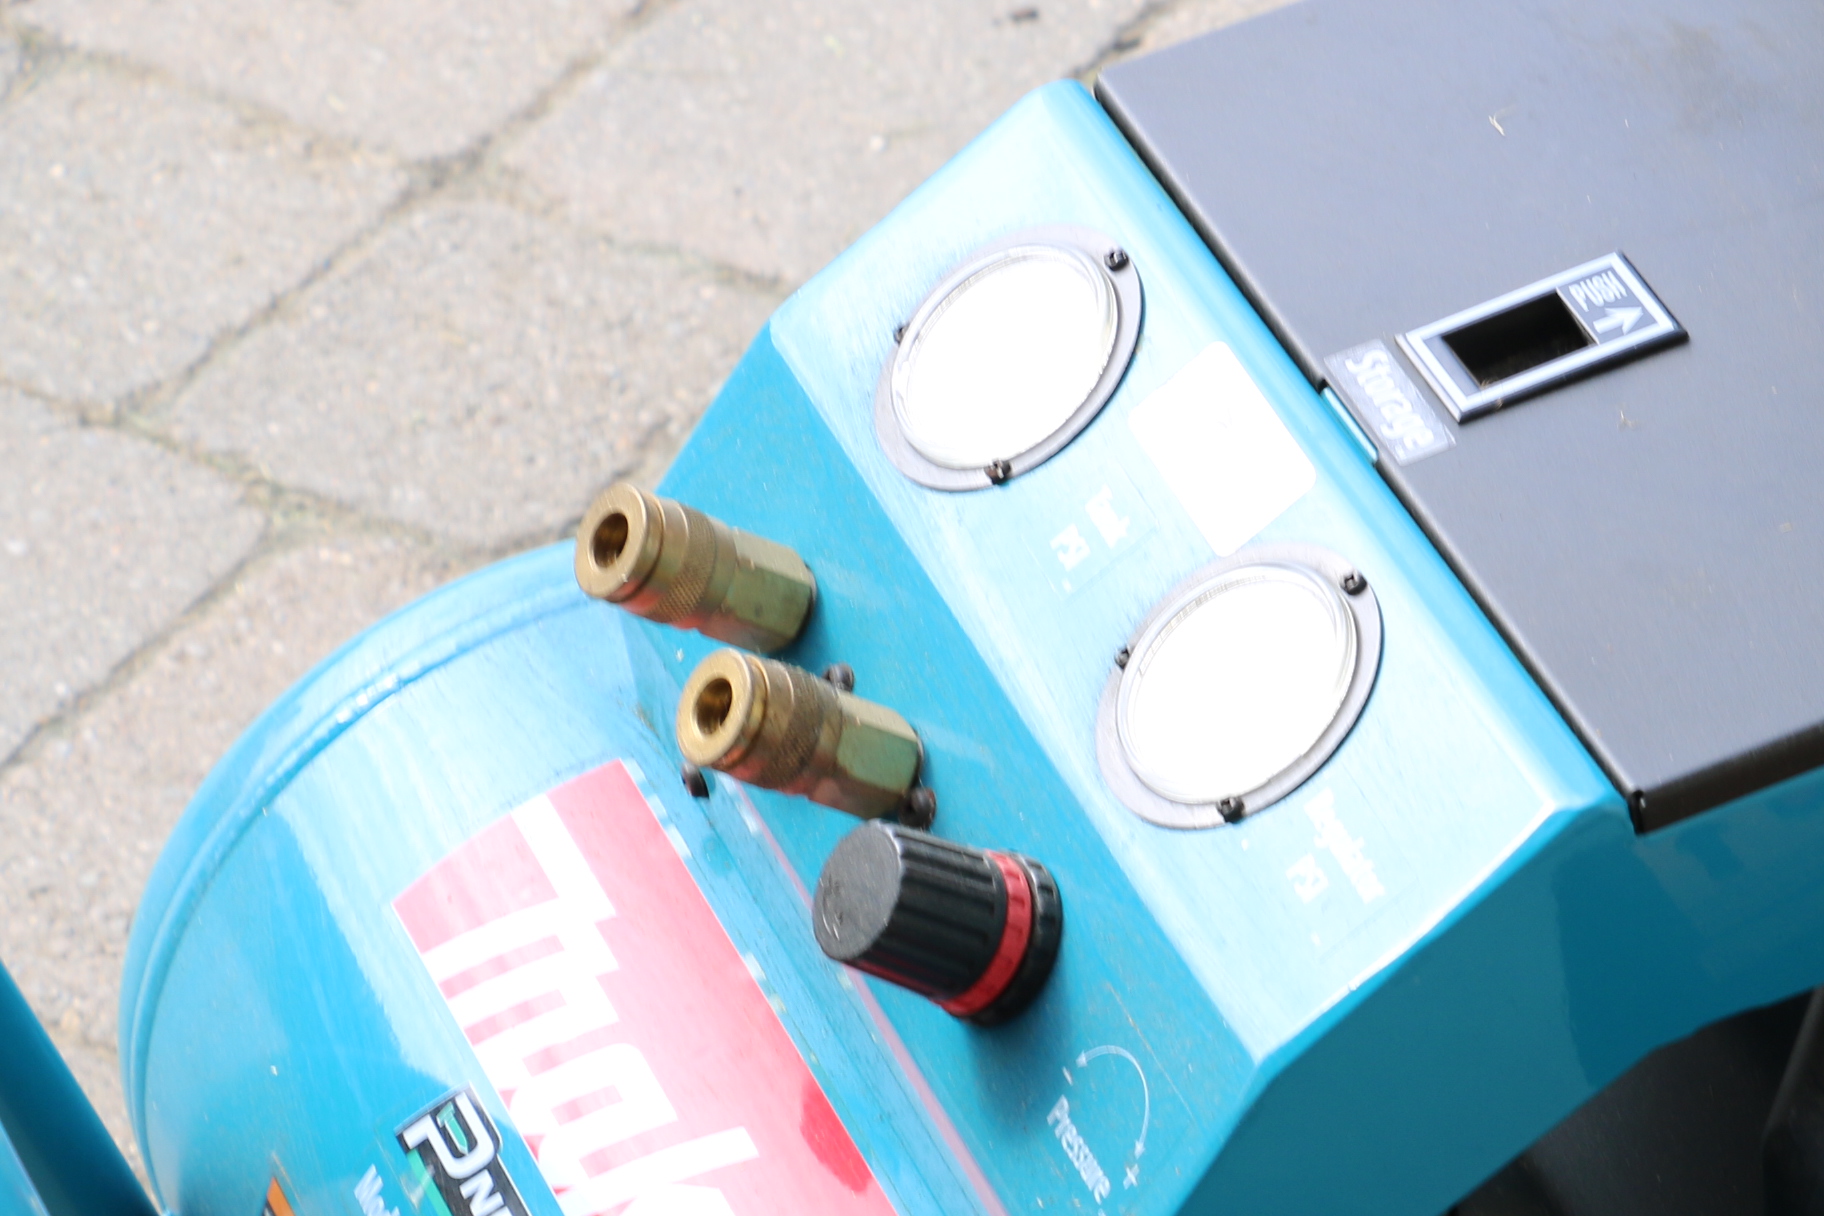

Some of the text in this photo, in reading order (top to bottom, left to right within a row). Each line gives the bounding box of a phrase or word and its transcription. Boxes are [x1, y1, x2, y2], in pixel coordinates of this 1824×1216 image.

[1568, 270, 1627, 312] PUSH
[1345, 348, 1434, 449] Storage
[1047, 1094, 1111, 1205] Pressure
